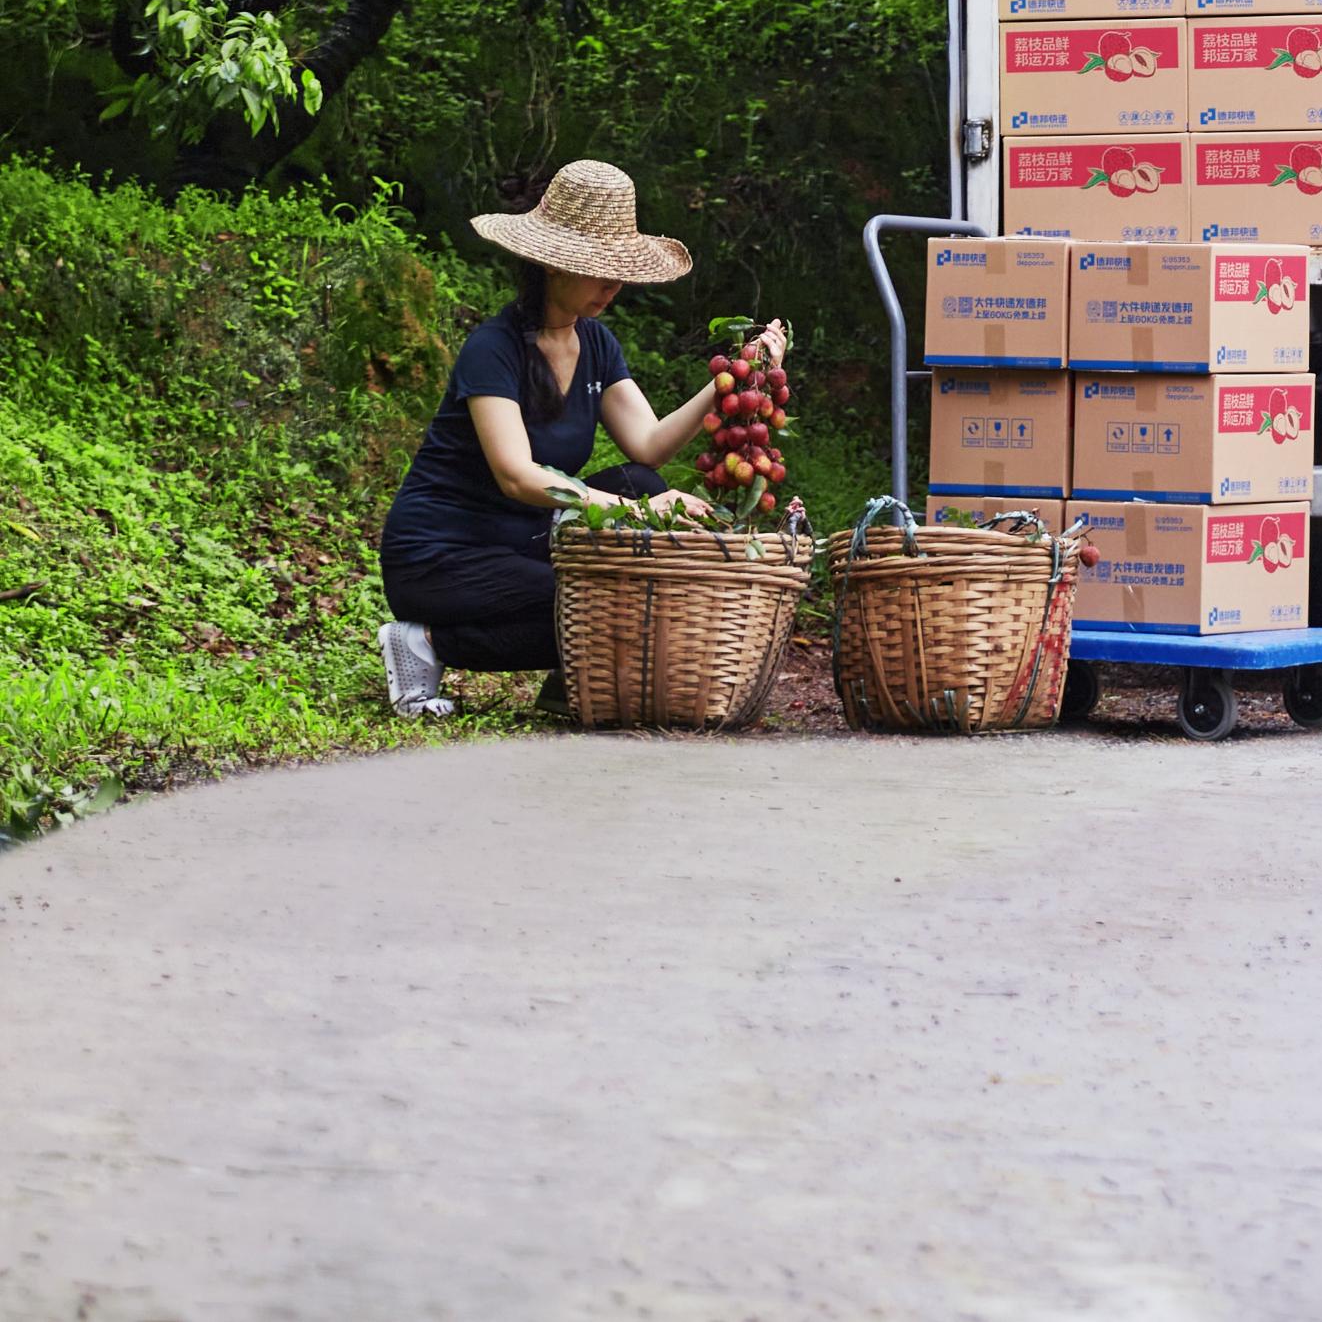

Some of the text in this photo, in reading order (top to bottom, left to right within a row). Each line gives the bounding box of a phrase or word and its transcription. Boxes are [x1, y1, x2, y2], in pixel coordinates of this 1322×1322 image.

[1015, 37, 1069, 51] 荔枝品鲜
[1203, 33, 1257, 47] 荔枝品鲜
[1016, 52, 1069, 66] 邦运万家
[1203, 48, 1257, 62] 邦运万家
[1018, 151, 1072, 166] 荔枝品鲜
[1206, 149, 1260, 164] 荔枝品鲜
[1019, 167, 1072, 181] 邦运万家
[1206, 164, 1260, 178] 邦运万家
[1220, 263, 1249, 278] 荔枝品鲜
[1220, 280, 1249, 294] 邦运万家
[974, 297, 1047, 309] 大件快递发德邦
[1119, 302, 1193, 313] 大件快递发德邦
[1224, 394, 1253, 409] 荔枝品鲜
[1223, 411, 1253, 425] 邦运万家
[1212, 523, 1243, 539] 荔枝品鲜
[1212, 540, 1243, 555] 邦运万家
[1113, 563, 1185, 574] 大件快递发德邦
